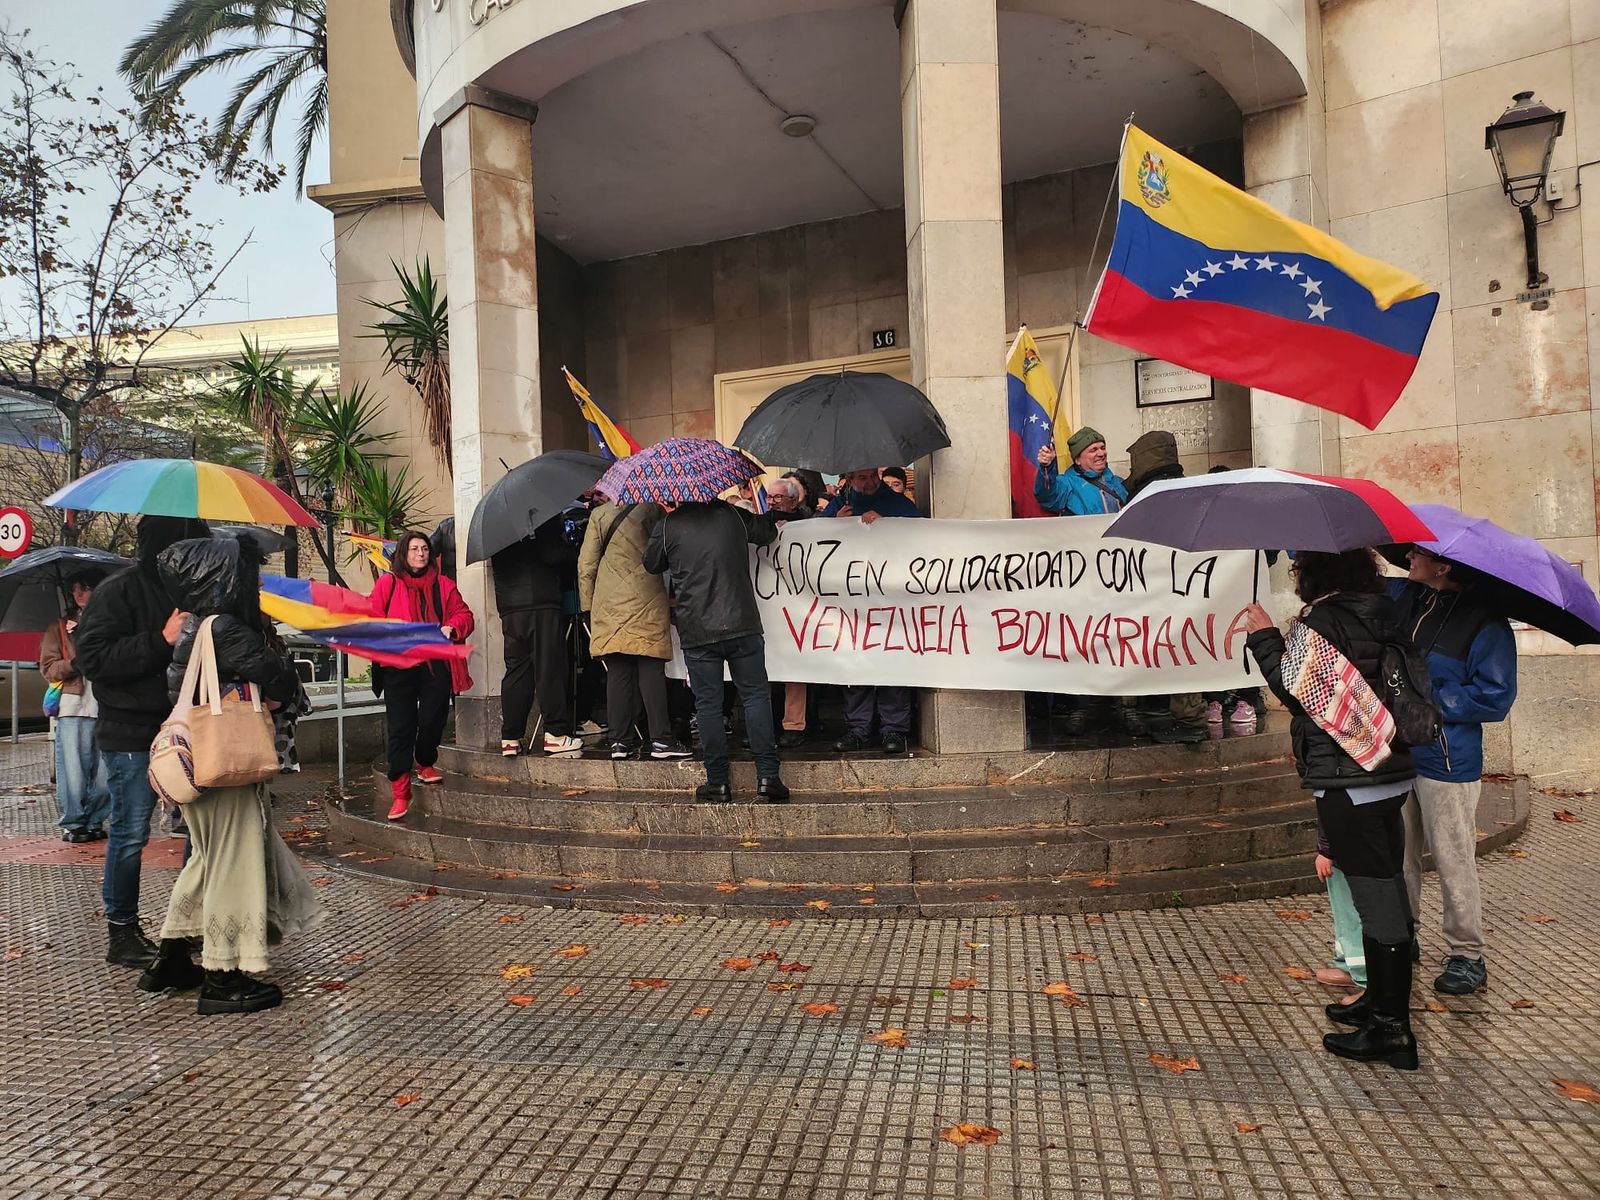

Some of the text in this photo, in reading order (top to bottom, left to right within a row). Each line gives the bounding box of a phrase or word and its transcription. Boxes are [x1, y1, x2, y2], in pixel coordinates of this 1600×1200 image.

[1, 524, 21, 540] 30
[755, 531, 1218, 600] CÁDIZ EN SOLIDARIDAD CON LA
[783, 597, 971, 656] VENEZUELA
